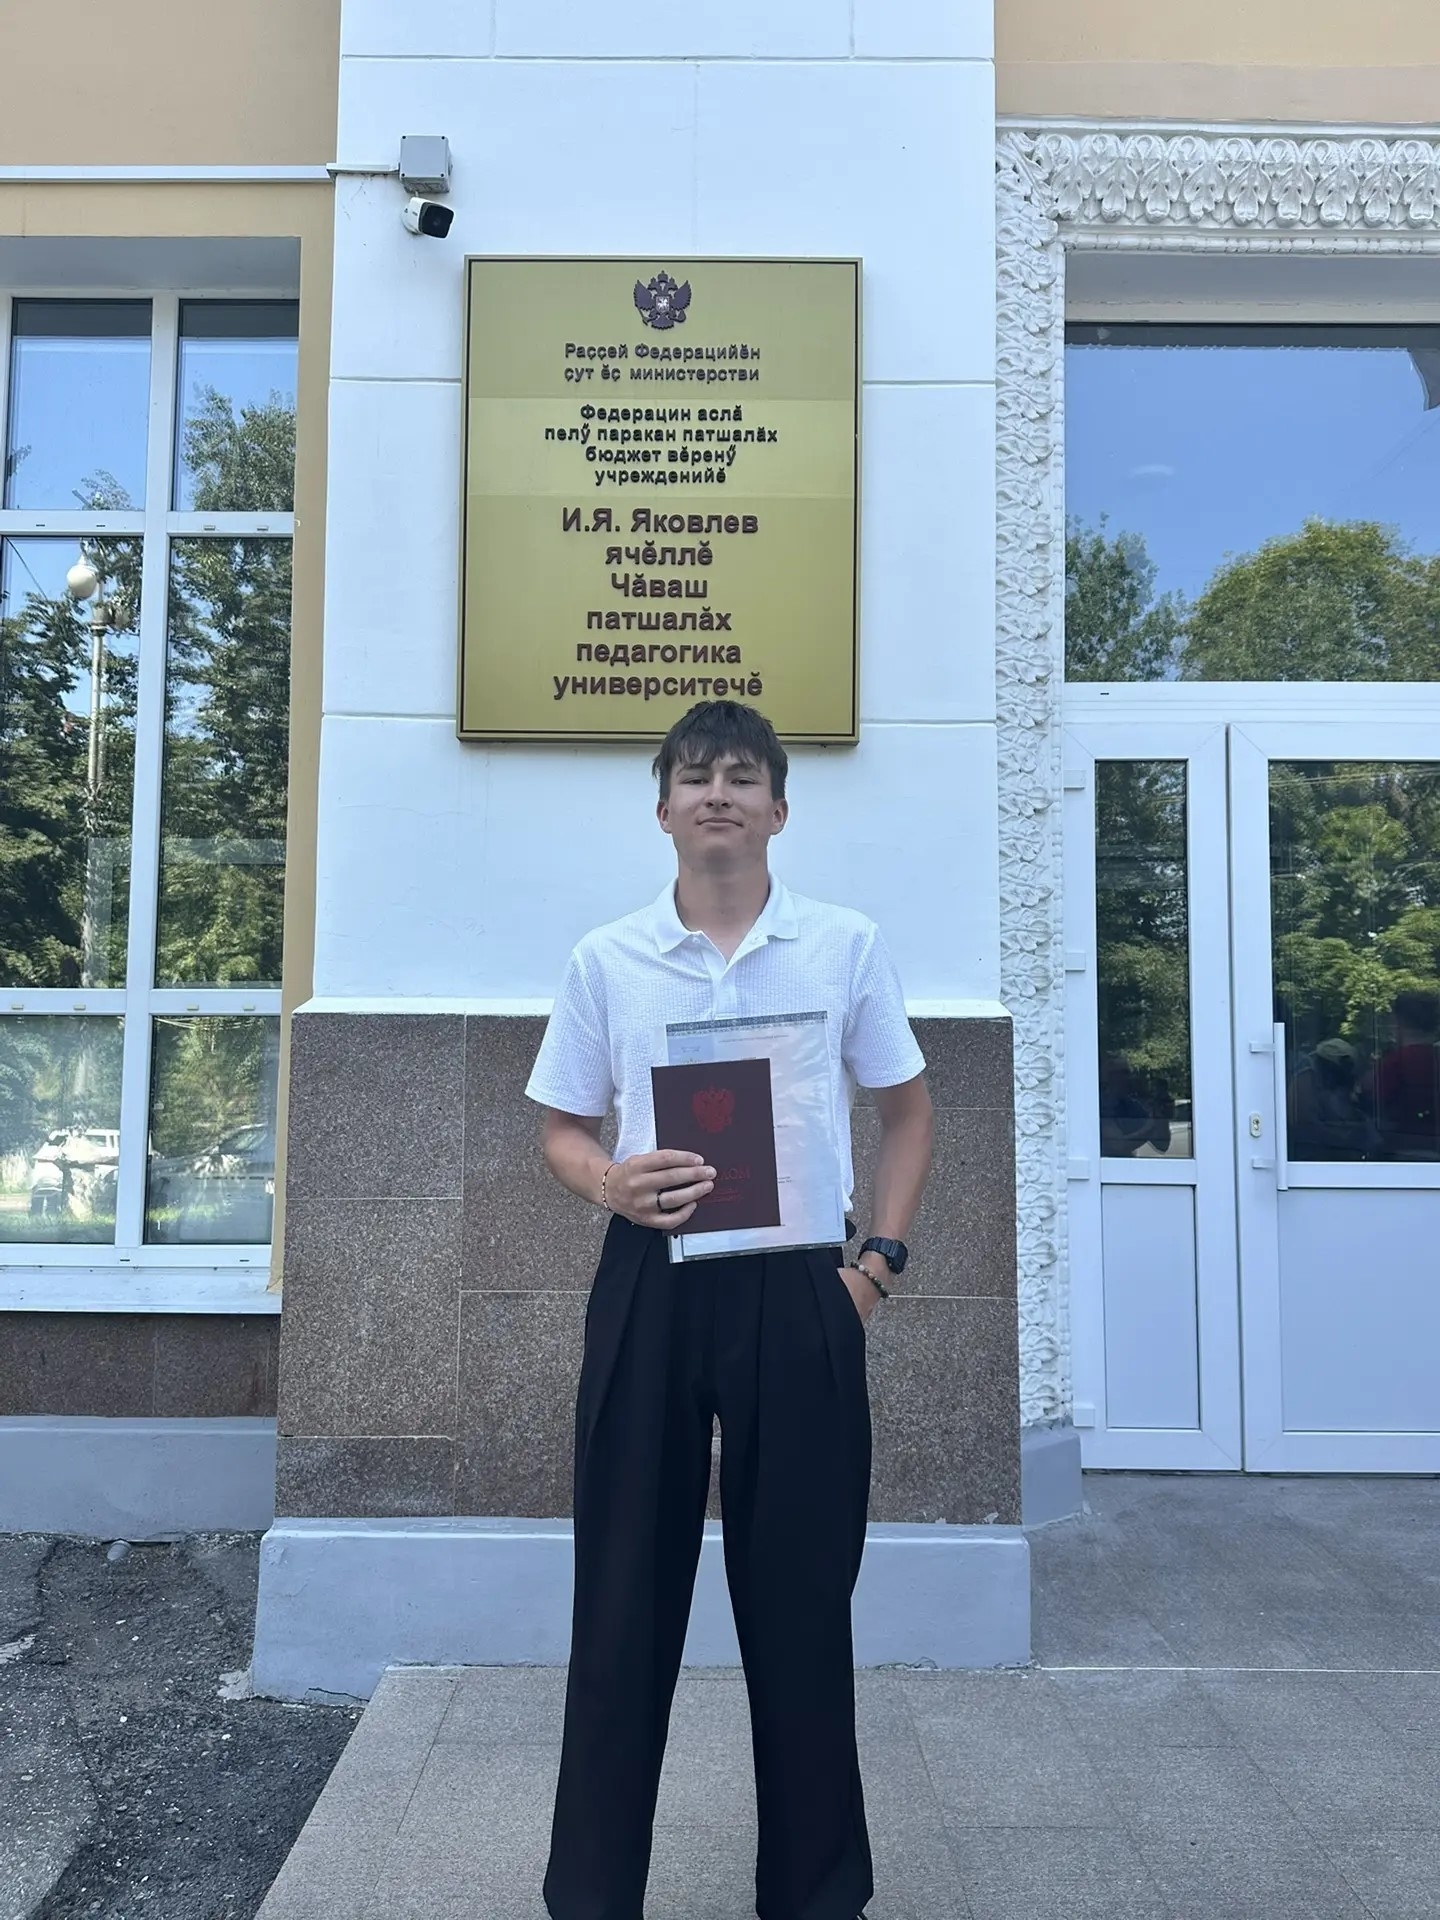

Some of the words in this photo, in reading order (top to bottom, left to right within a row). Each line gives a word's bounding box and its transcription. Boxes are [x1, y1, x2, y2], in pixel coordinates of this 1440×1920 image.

[564, 342, 629, 362] Раҫҫей
[634, 342, 761, 364] Федерацийӗн
[563, 367, 595, 384] ҫут
[600, 363, 621, 383] ӗҫ
[629, 367, 760, 385] министерстви
[580, 403, 691, 425] Федерацин
[697, 404, 743, 423] аслӑ
[597, 428, 677, 445] паракан
[682, 426, 778, 444] патшалӑх
[585, 445, 662, 465] бюджет
[594, 466, 727, 487] учрежденийӗ
[562, 506, 621, 533] И.Я.
[630, 507, 759, 535] Яковлев
[604, 539, 714, 567] ячӗллӗ
[610, 572, 708, 599] Чӑваш
[586, 605, 733, 632] патшалӑх
[576, 643, 742, 668] педагогика
[552, 671, 763, 702] университечӗ
